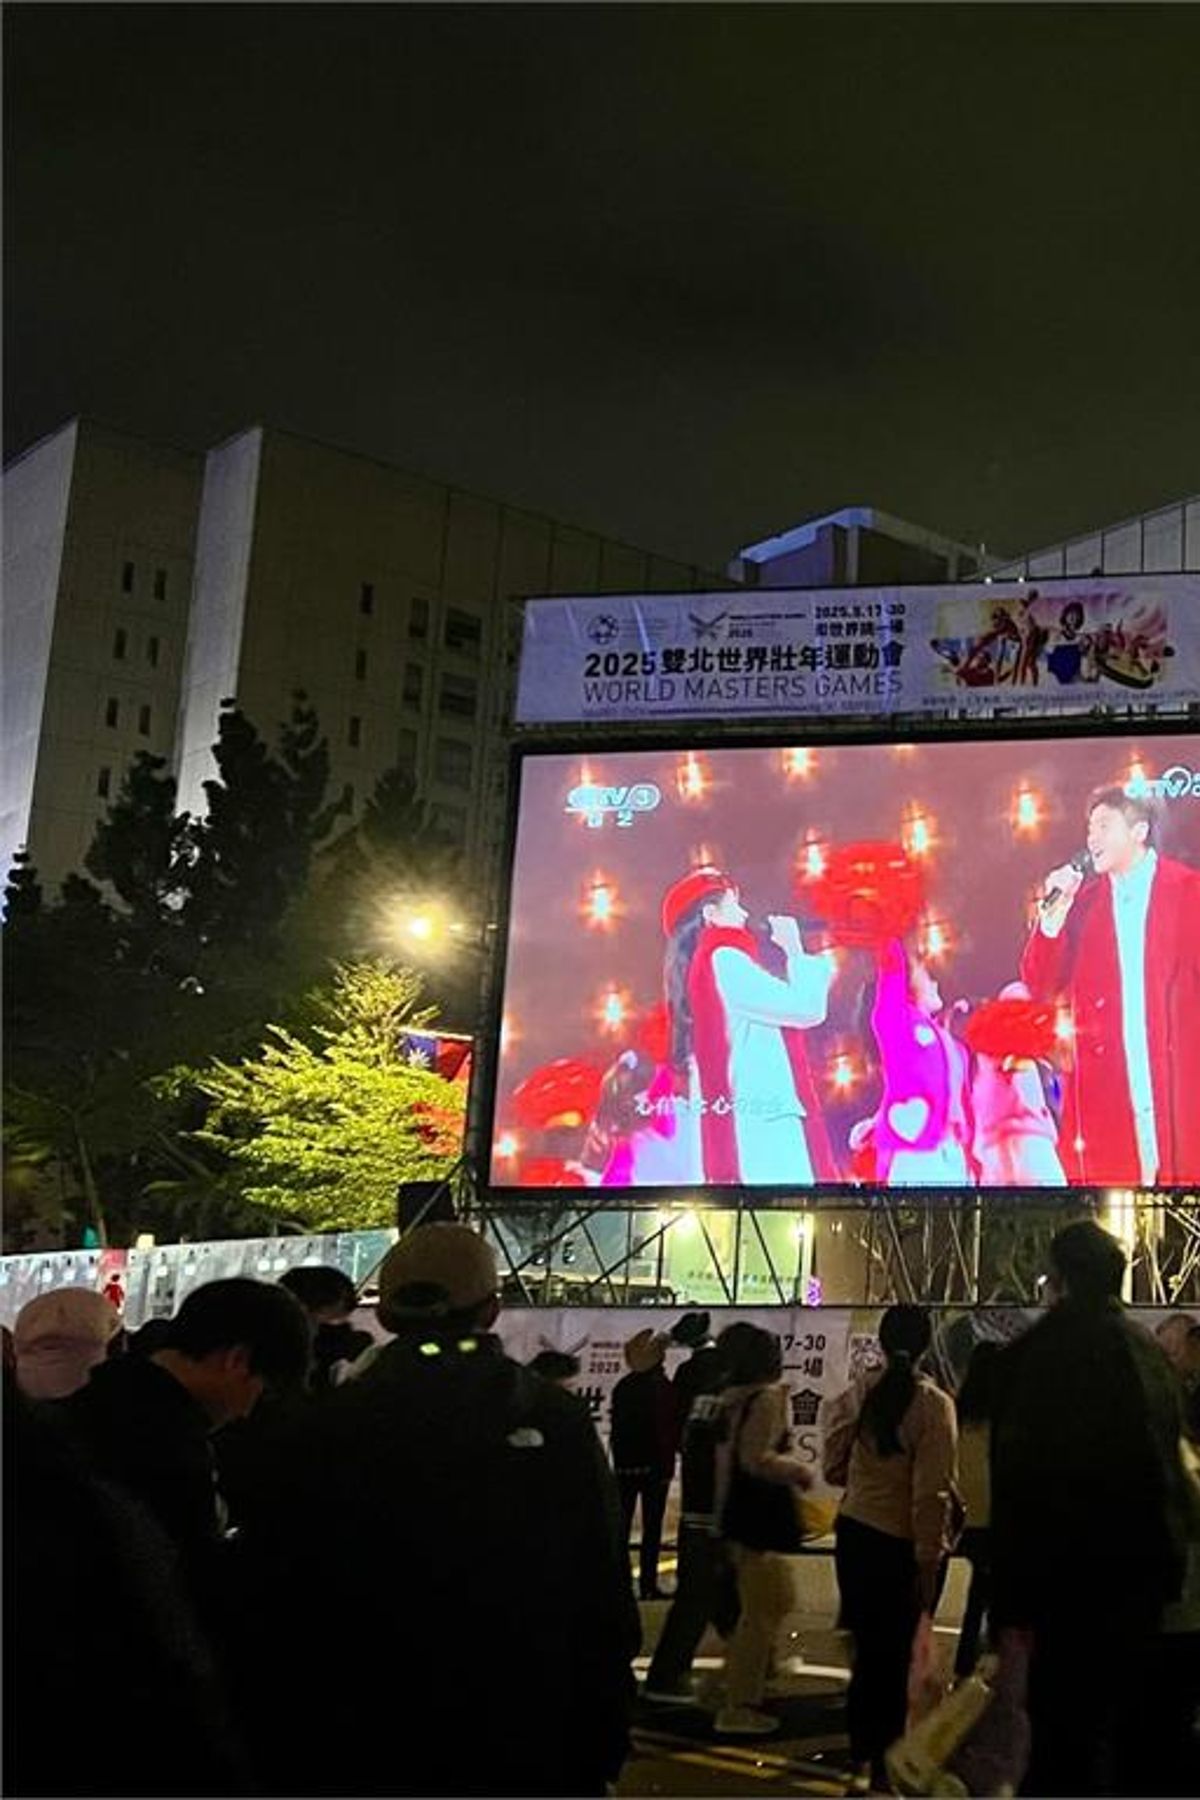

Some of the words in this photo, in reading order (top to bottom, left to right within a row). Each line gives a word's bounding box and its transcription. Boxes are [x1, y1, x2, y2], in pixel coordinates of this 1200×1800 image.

[584, 641, 904, 677] 2025雙北世界壯年運動會
[584, 679, 675, 702] WORLD
[684, 675, 806, 699] MASTERS
[815, 669, 904, 697] GAMES
